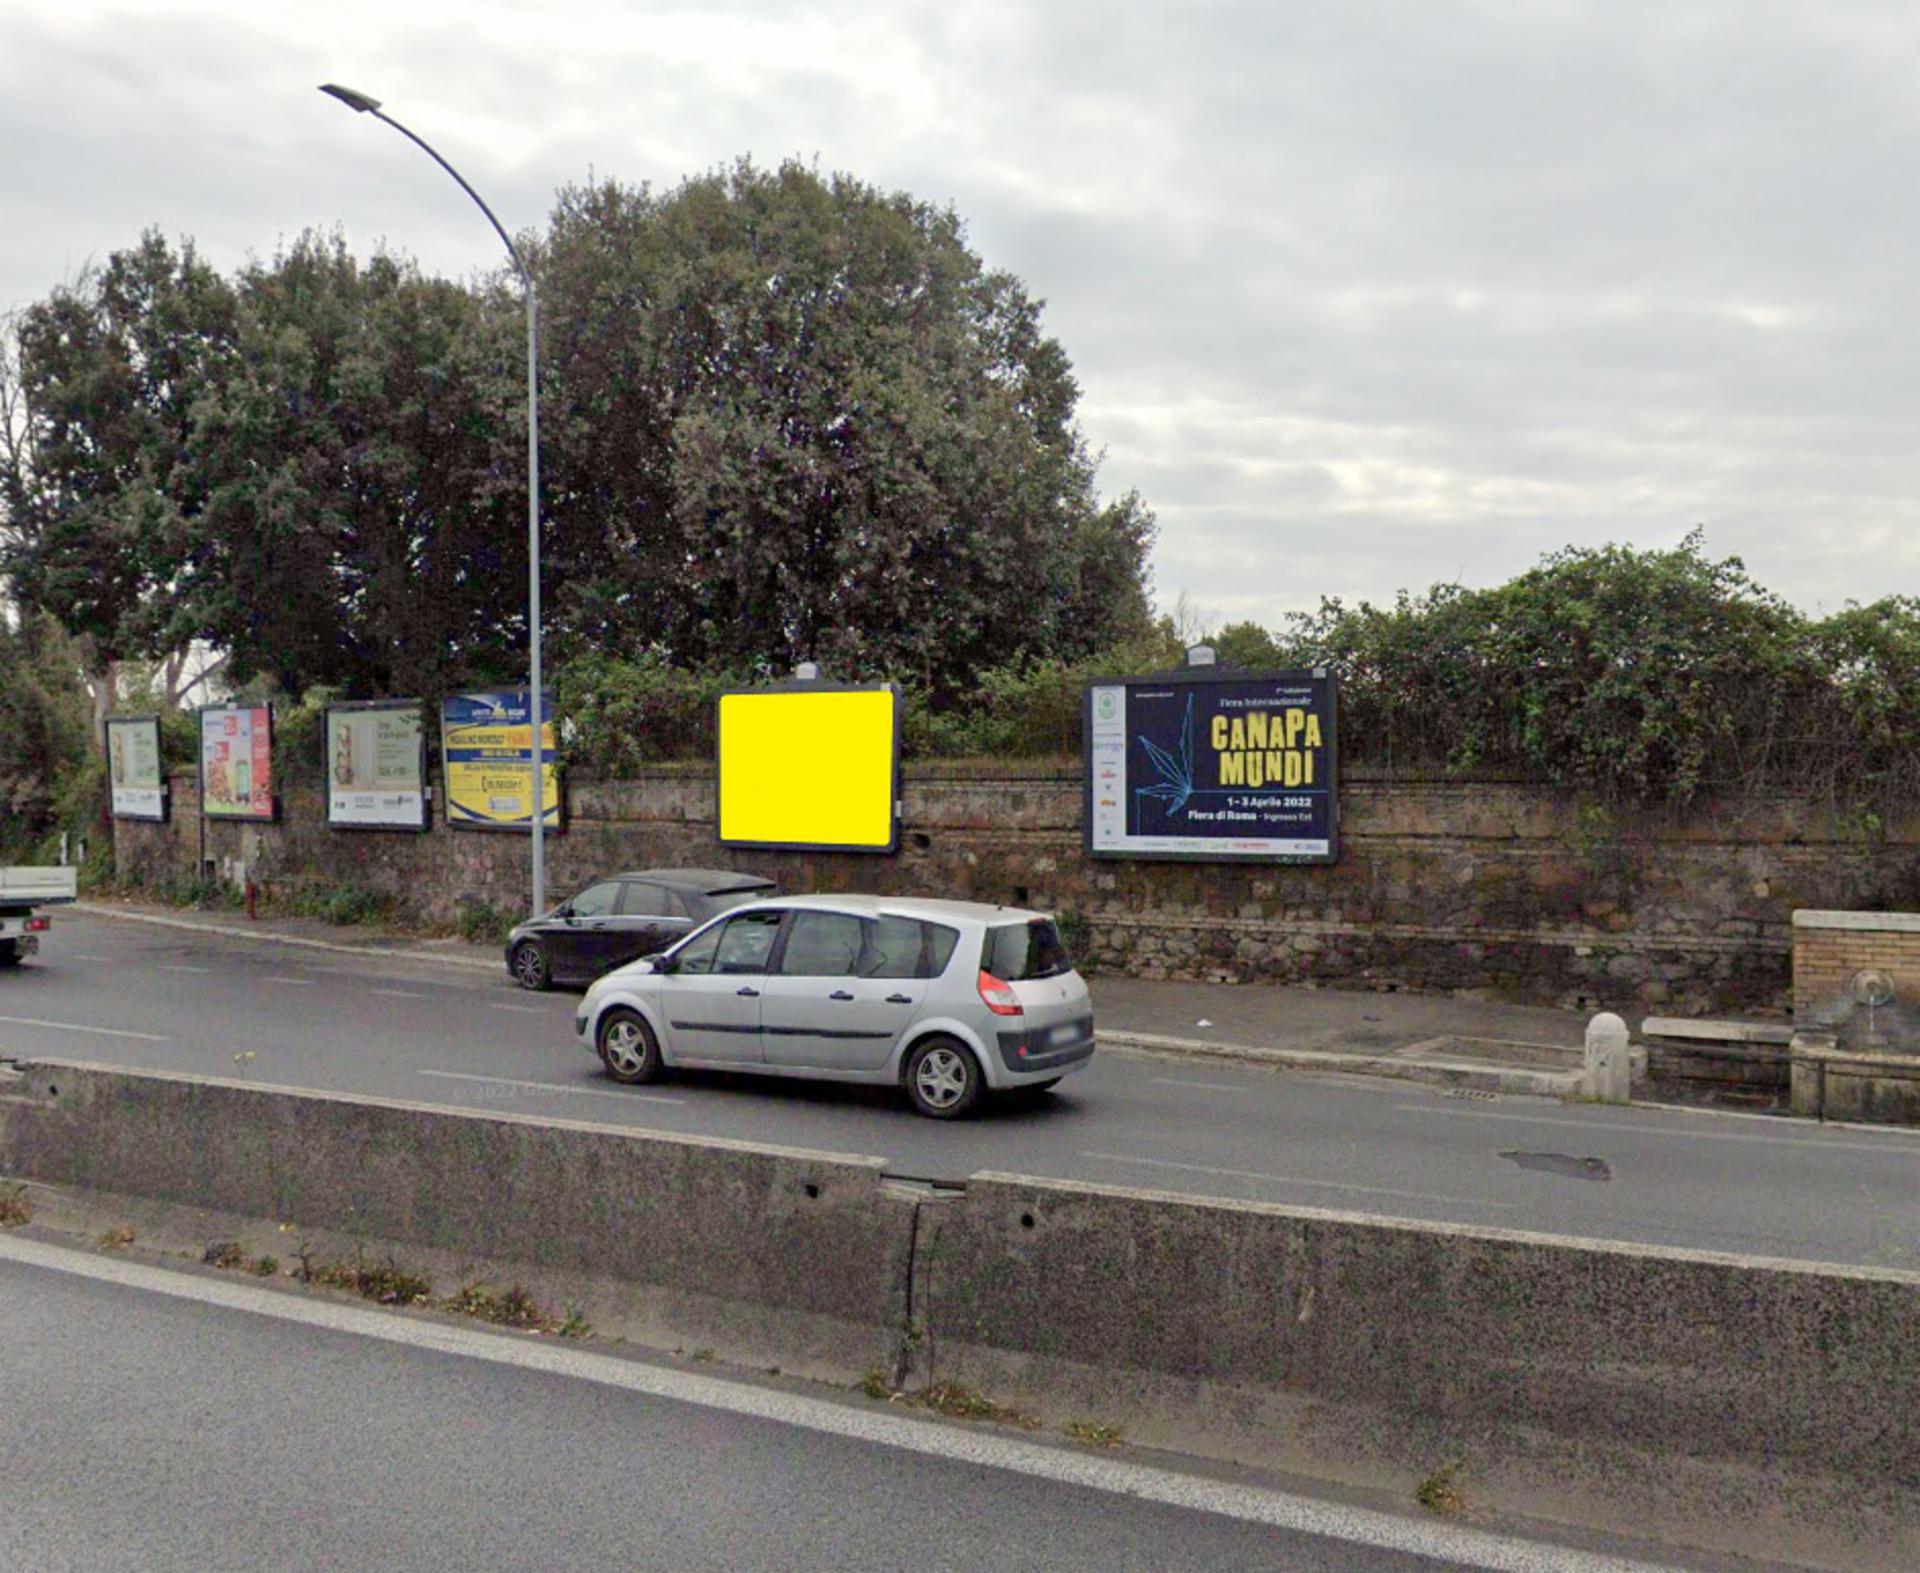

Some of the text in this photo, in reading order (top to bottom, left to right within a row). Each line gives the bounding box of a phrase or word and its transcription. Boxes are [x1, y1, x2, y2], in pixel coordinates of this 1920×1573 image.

[1211, 708, 1322, 751] CANAPA
[1219, 749, 1314, 788] MUNDI
[1250, 796, 1281, 808] Aprile
[1283, 796, 1312, 808] 2022
[1188, 810, 1214, 820] Fiera
[1215, 810, 1226, 820] di
[1227, 810, 1257, 820] Roma
